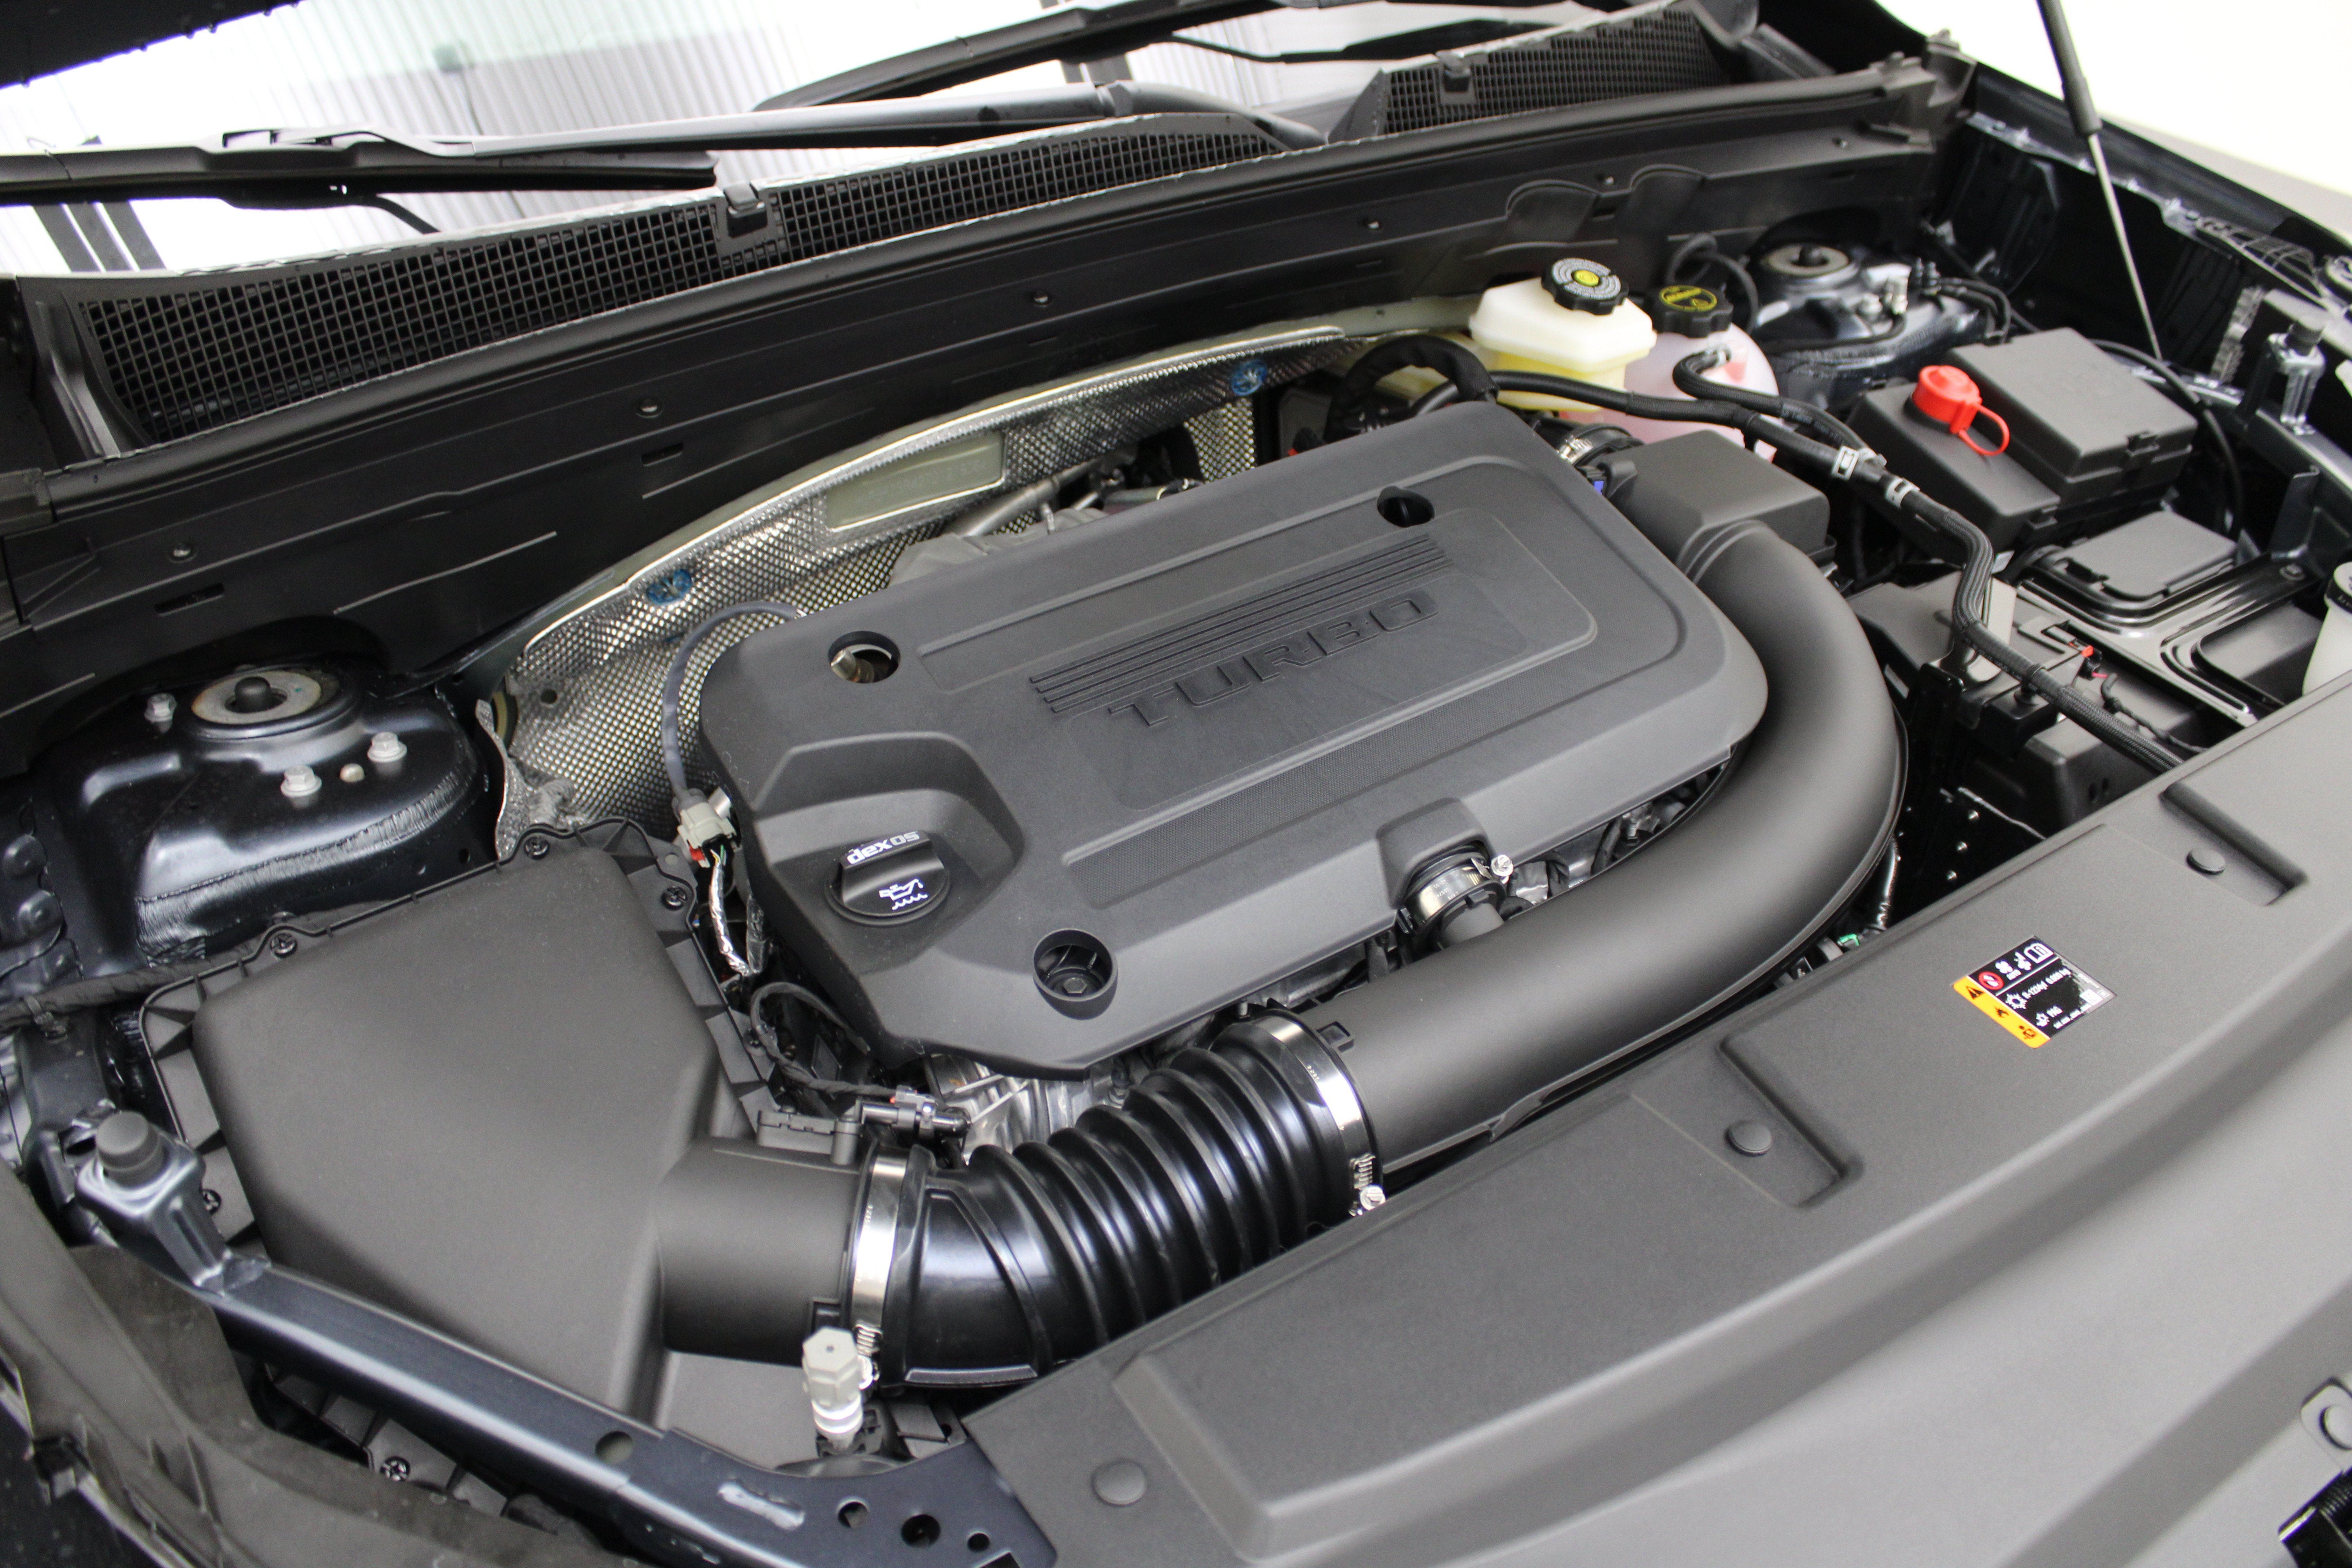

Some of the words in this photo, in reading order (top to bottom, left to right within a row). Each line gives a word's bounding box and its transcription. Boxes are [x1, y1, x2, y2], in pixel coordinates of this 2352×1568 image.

[1109, 588, 1439, 728] TURBO
[847, 831, 920, 864] dexos
[2046, 1005, 2063, 1018] PAG
